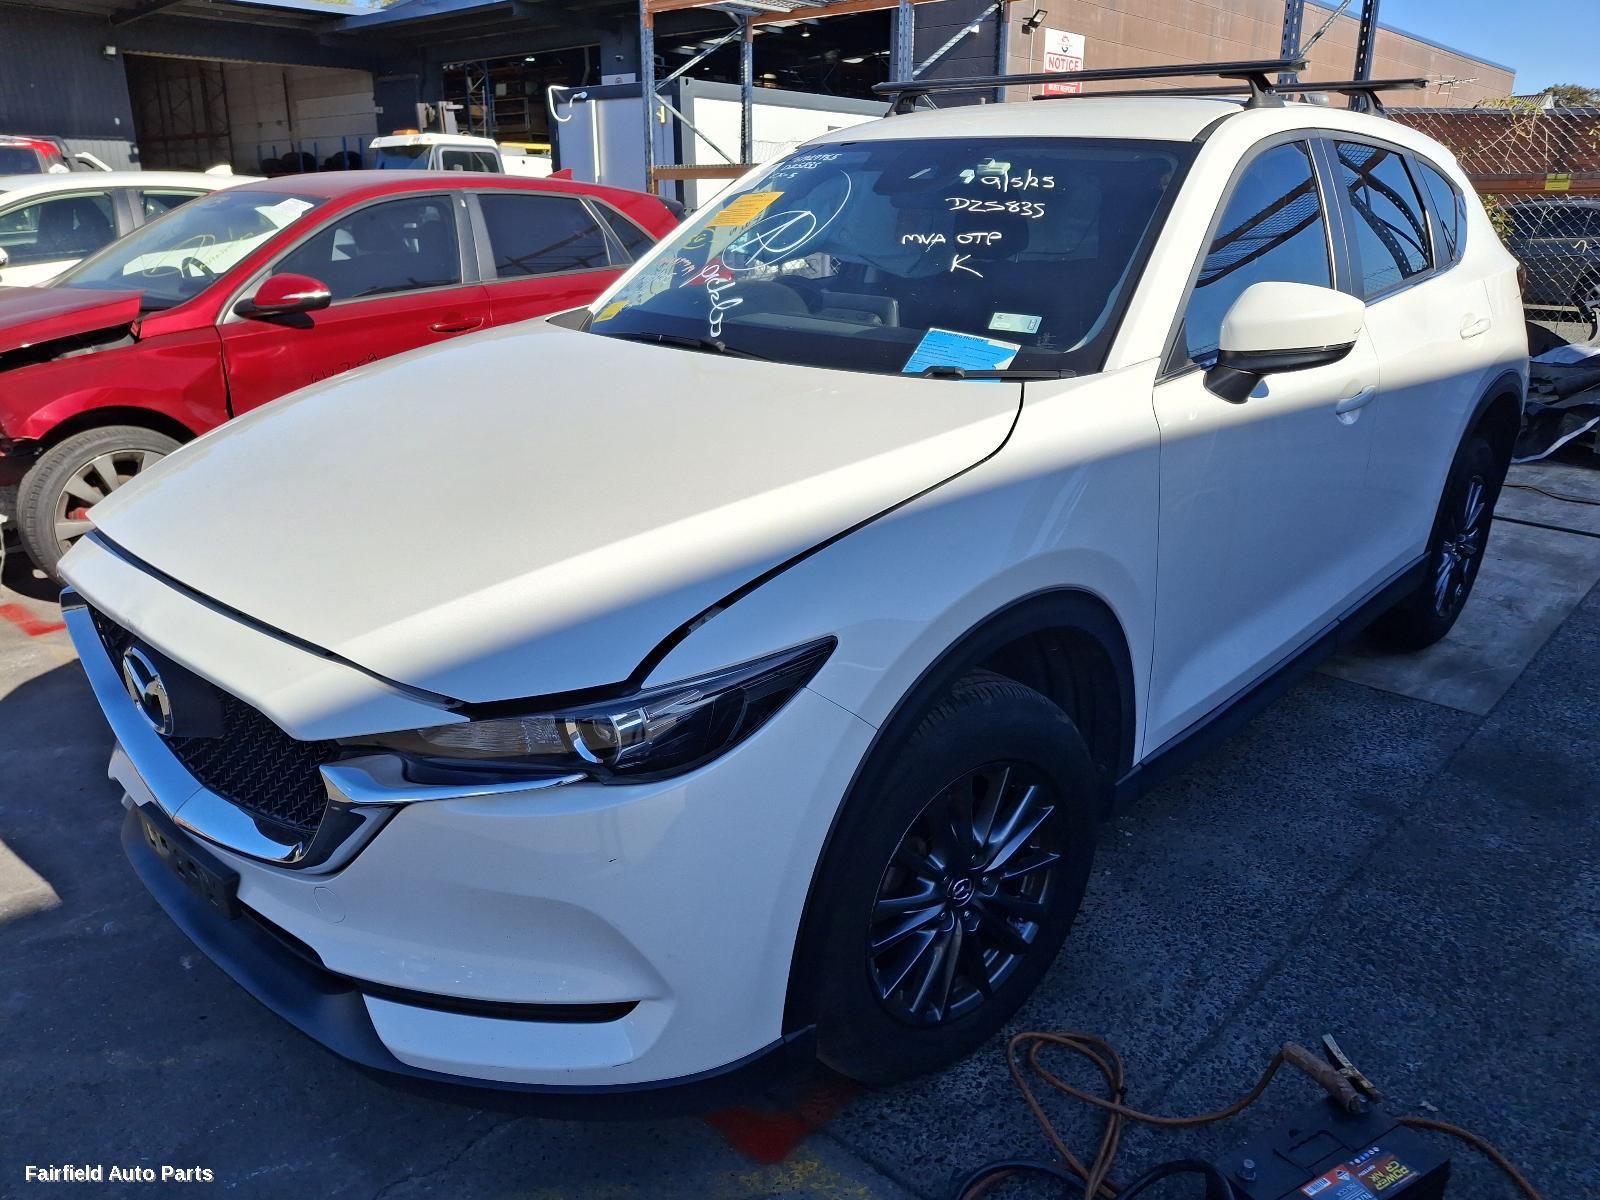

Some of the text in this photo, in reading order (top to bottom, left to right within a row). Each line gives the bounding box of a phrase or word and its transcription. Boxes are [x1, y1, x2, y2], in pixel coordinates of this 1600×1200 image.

[1048, 56, 1079, 71] NOTICE
[956, 231, 1003, 246] OTP
[950, 254, 984, 278] K
[1368, 1160, 1400, 1183] CRNK
[1374, 1165, 1410, 1191] POWER
